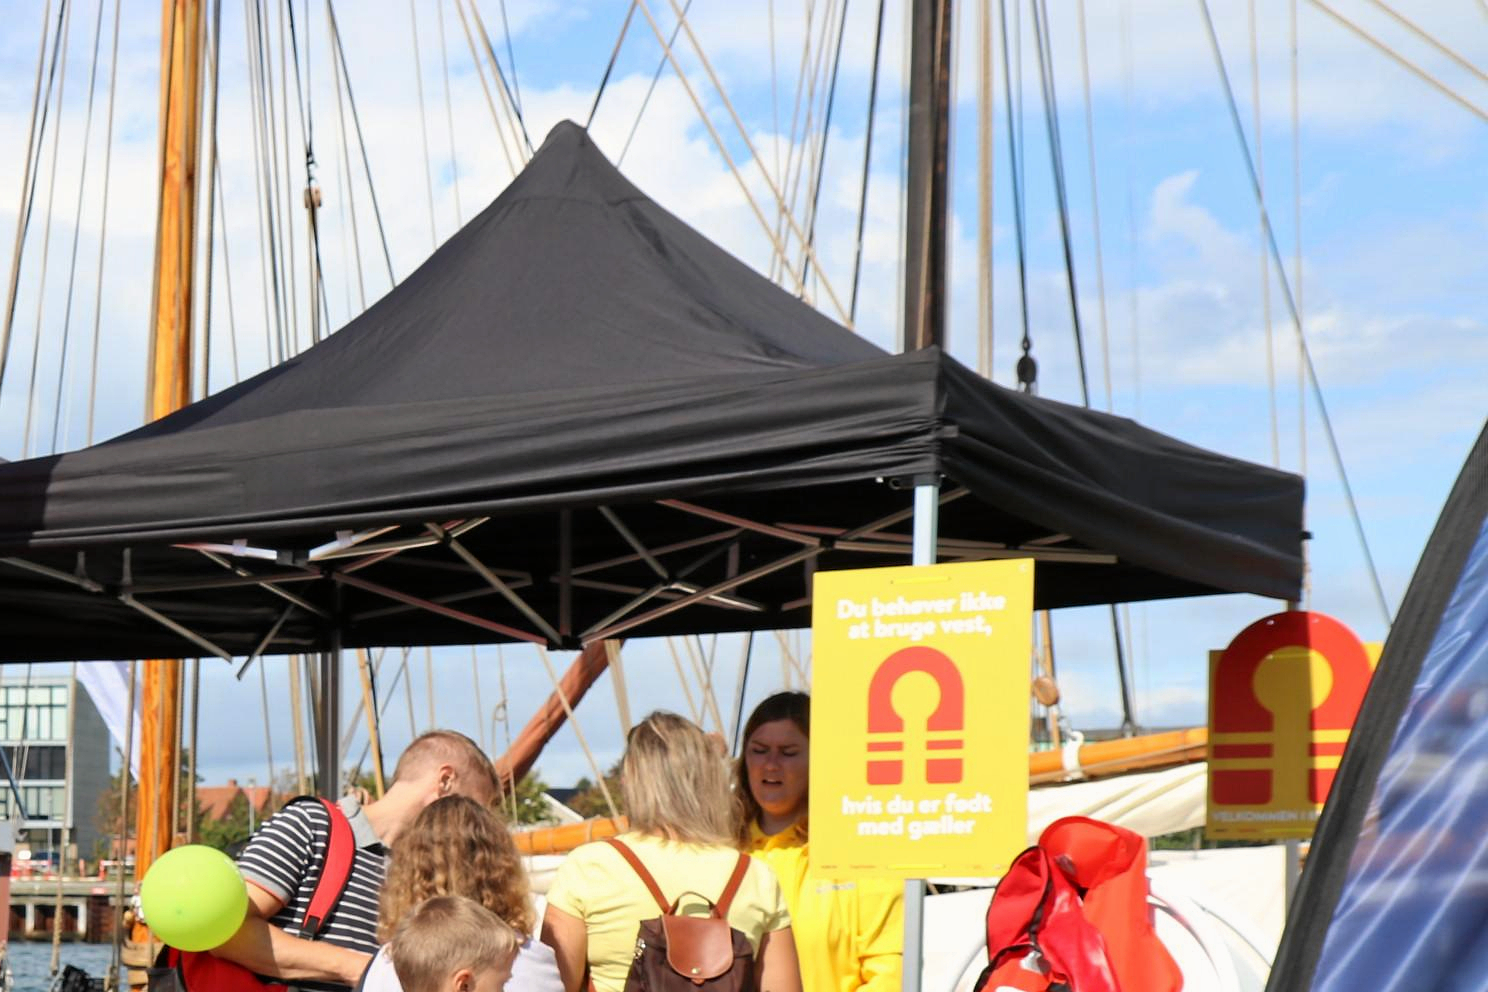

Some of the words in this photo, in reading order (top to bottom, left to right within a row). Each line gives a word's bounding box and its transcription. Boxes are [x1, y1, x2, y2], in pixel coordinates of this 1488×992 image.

[837, 598, 867, 619] Du
[960, 592, 1005, 612] ikke
[848, 621, 870, 639] at
[874, 618, 935, 641] bruge
[940, 614, 992, 637] vest,
[842, 794, 883, 815] hvis
[887, 794, 914, 814] du
[918, 798, 941, 814] er
[857, 817, 904, 836] med
[908, 816, 976, 841] gæller
